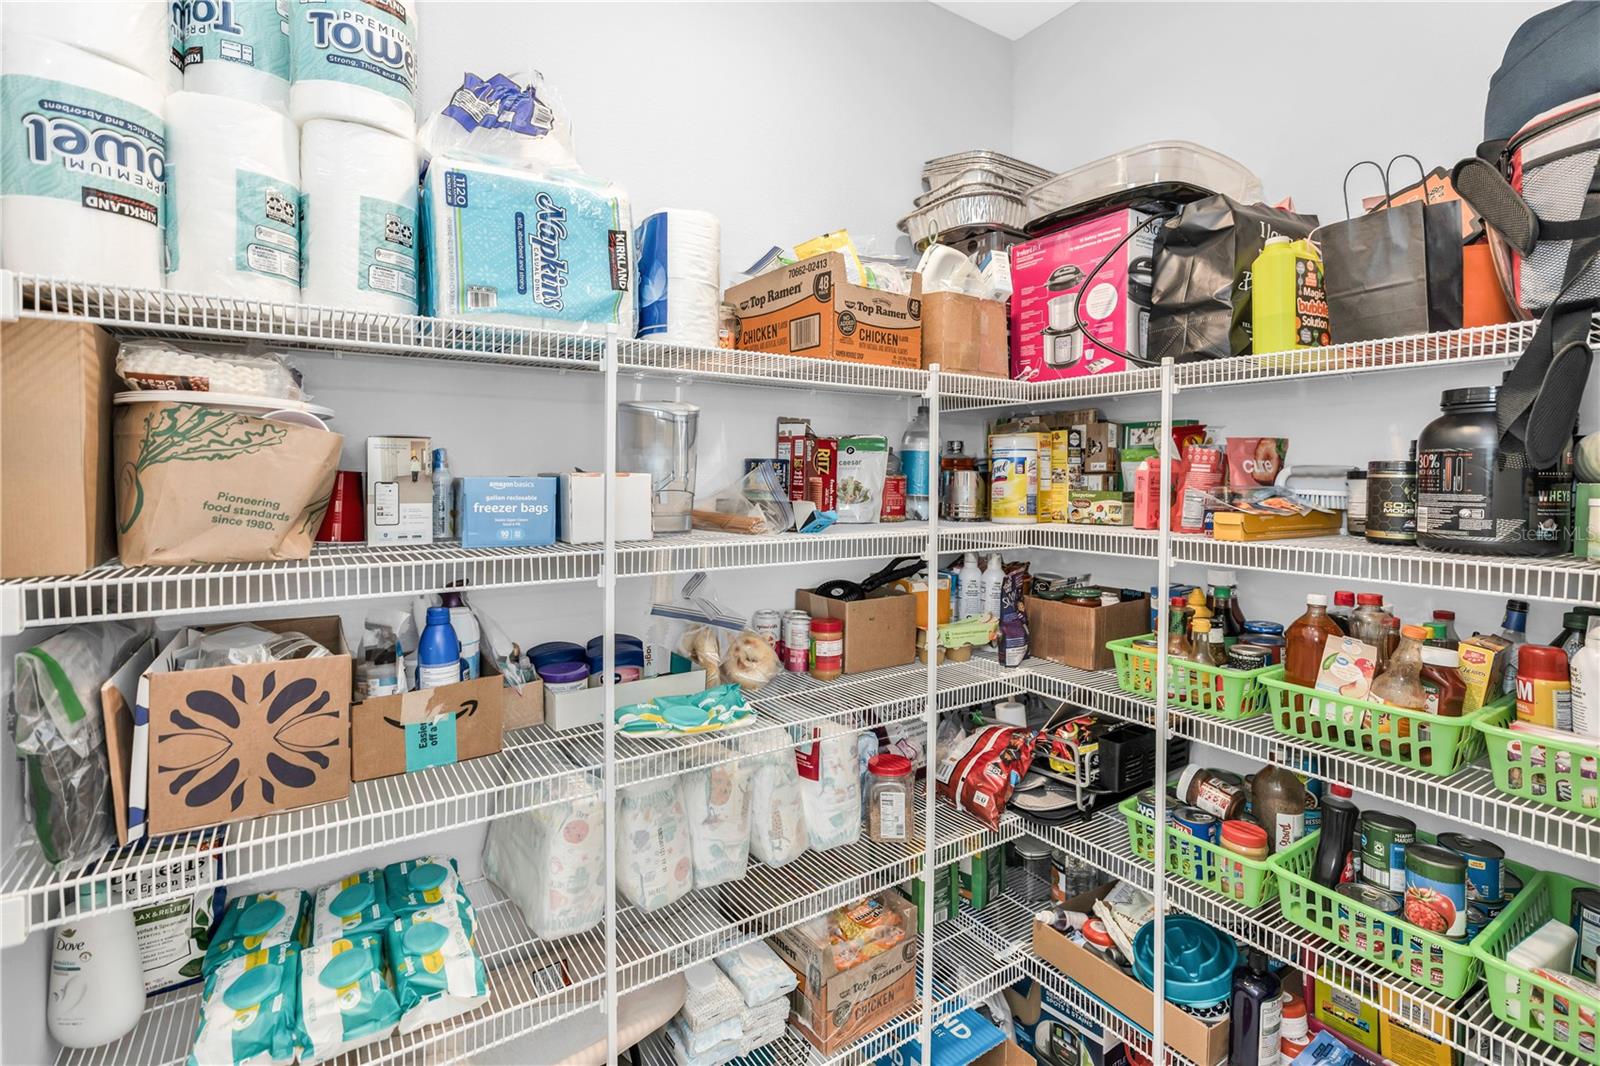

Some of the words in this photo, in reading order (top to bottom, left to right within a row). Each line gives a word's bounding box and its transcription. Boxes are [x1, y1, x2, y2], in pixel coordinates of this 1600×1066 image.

[360, 61, 381, 74] Thick
[44, 101, 102, 120] Absorbent
[105, 115, 125, 127] and
[28, 117, 165, 182] owel
[70, 157, 161, 195] PREMIUM
[456, 177, 466, 206] 1120
[86, 196, 157, 223] KIRKLAND
[517, 230, 525, 259] absorbent
[532, 193, 568, 311] Napkins
[615, 234, 627, 289] KIRKLAND
[518, 271, 526, 289] strong
[818, 275, 829, 290] 48
[750, 296, 766, 309] Top
[767, 284, 801, 303] Ramen
[1303, 287, 1325, 300] Magic
[857, 301, 874, 316] Top
[876, 305, 906, 320] Ramen
[1302, 315, 1327, 329] Solution
[743, 323, 778, 345] CHICKEN
[859, 328, 898, 346] CHICKEN
[818, 448, 830, 475] RITZ
[1243, 459, 1273, 474] cure
[217, 491, 280, 511] Pioneering
[473, 502, 518, 513] freezer
[520, 502, 549, 515] bags
[203, 500, 231, 514] food
[233, 504, 290, 522] standards
[211, 513, 242, 527] since
[246, 518, 275, 532] 1980.
[430, 733, 438, 746] off
[988, 763, 1007, 779] BOLD
[56, 937, 85, 951] Dove
[852, 981, 869, 993] Top
[871, 963, 902, 985] Ramen
[854, 990, 894, 1020] CHICKEN
[1045, 996, 1065, 1011] SPOTS
[1070, 1010, 1093, 1028] STAINS
